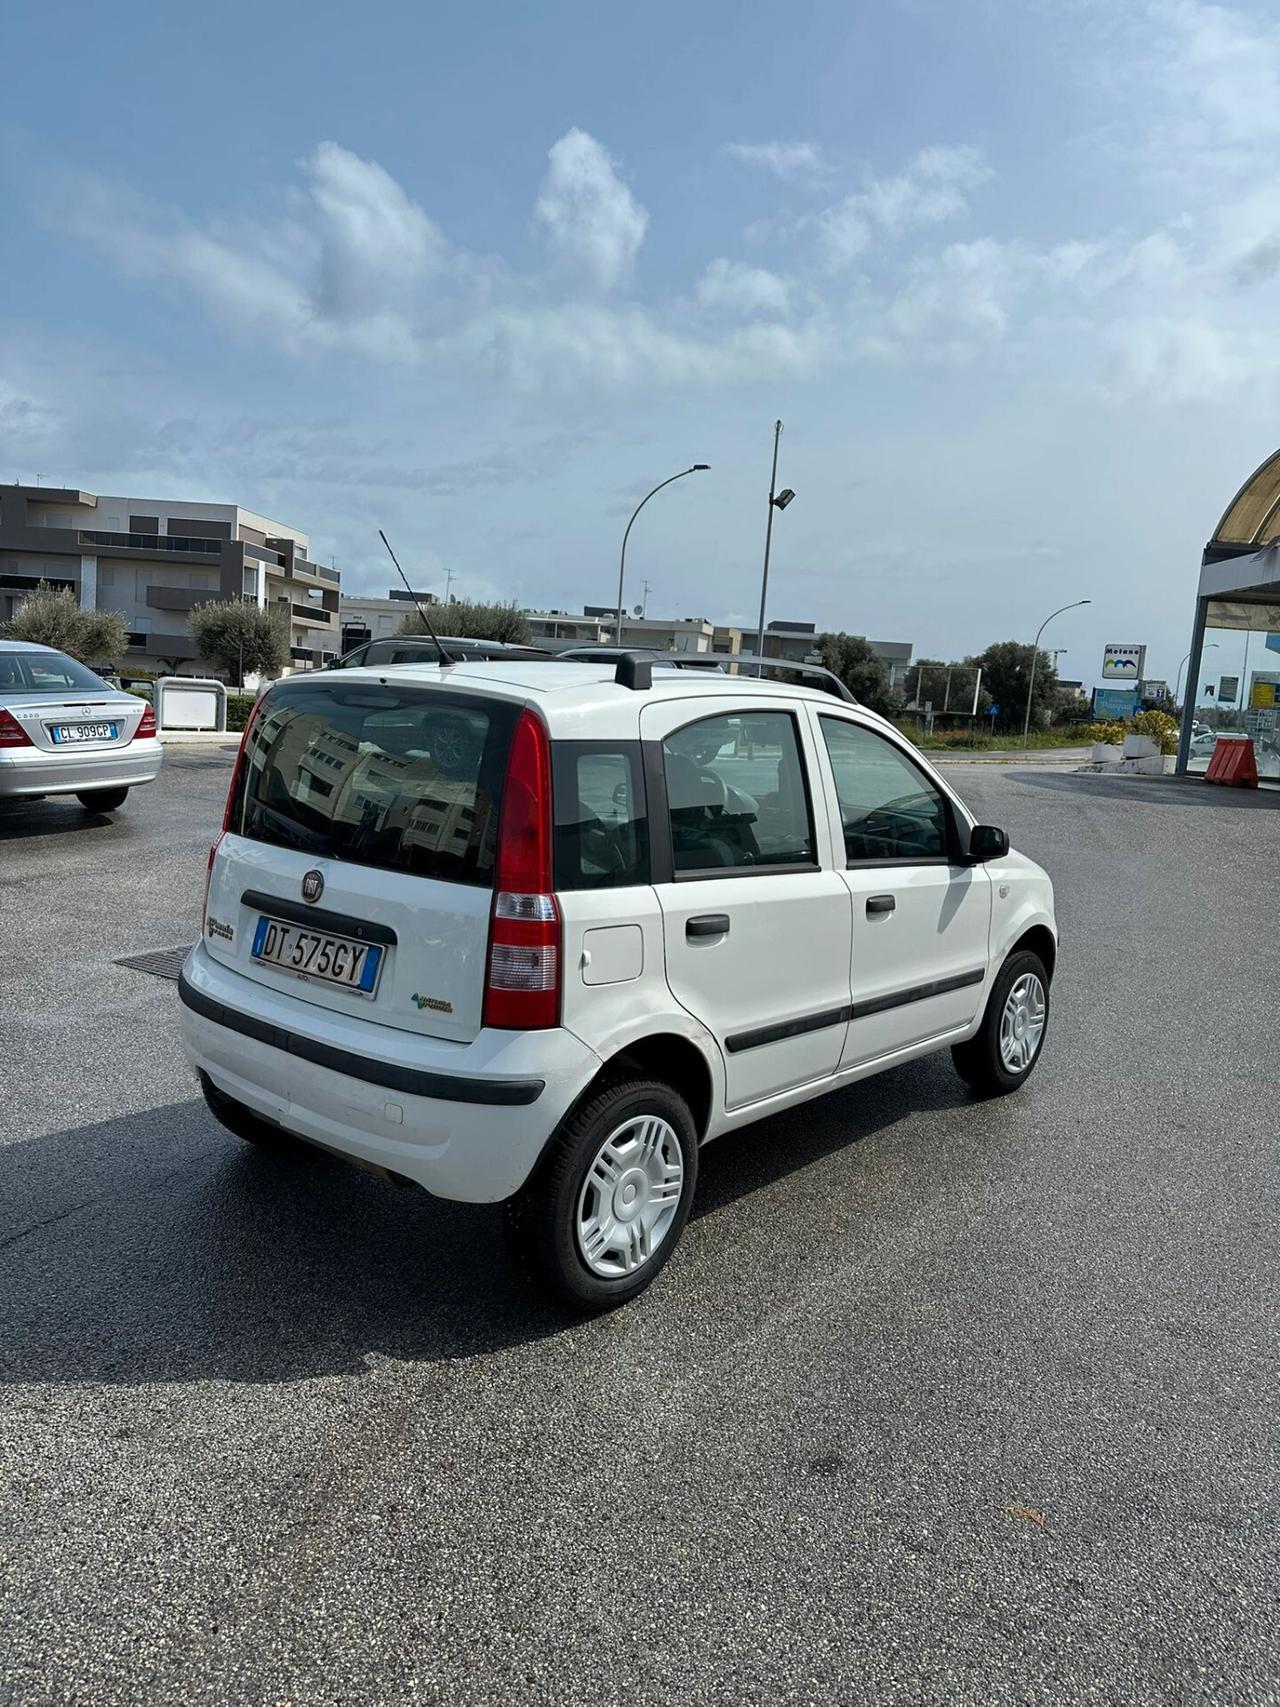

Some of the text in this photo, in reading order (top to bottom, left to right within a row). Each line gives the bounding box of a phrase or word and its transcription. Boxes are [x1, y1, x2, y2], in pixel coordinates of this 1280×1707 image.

[60, 724, 109, 739] CL 909GP
[304, 877, 319, 895] FIAT
[263, 924, 290, 960] DT
[292, 933, 365, 981] 575GY
